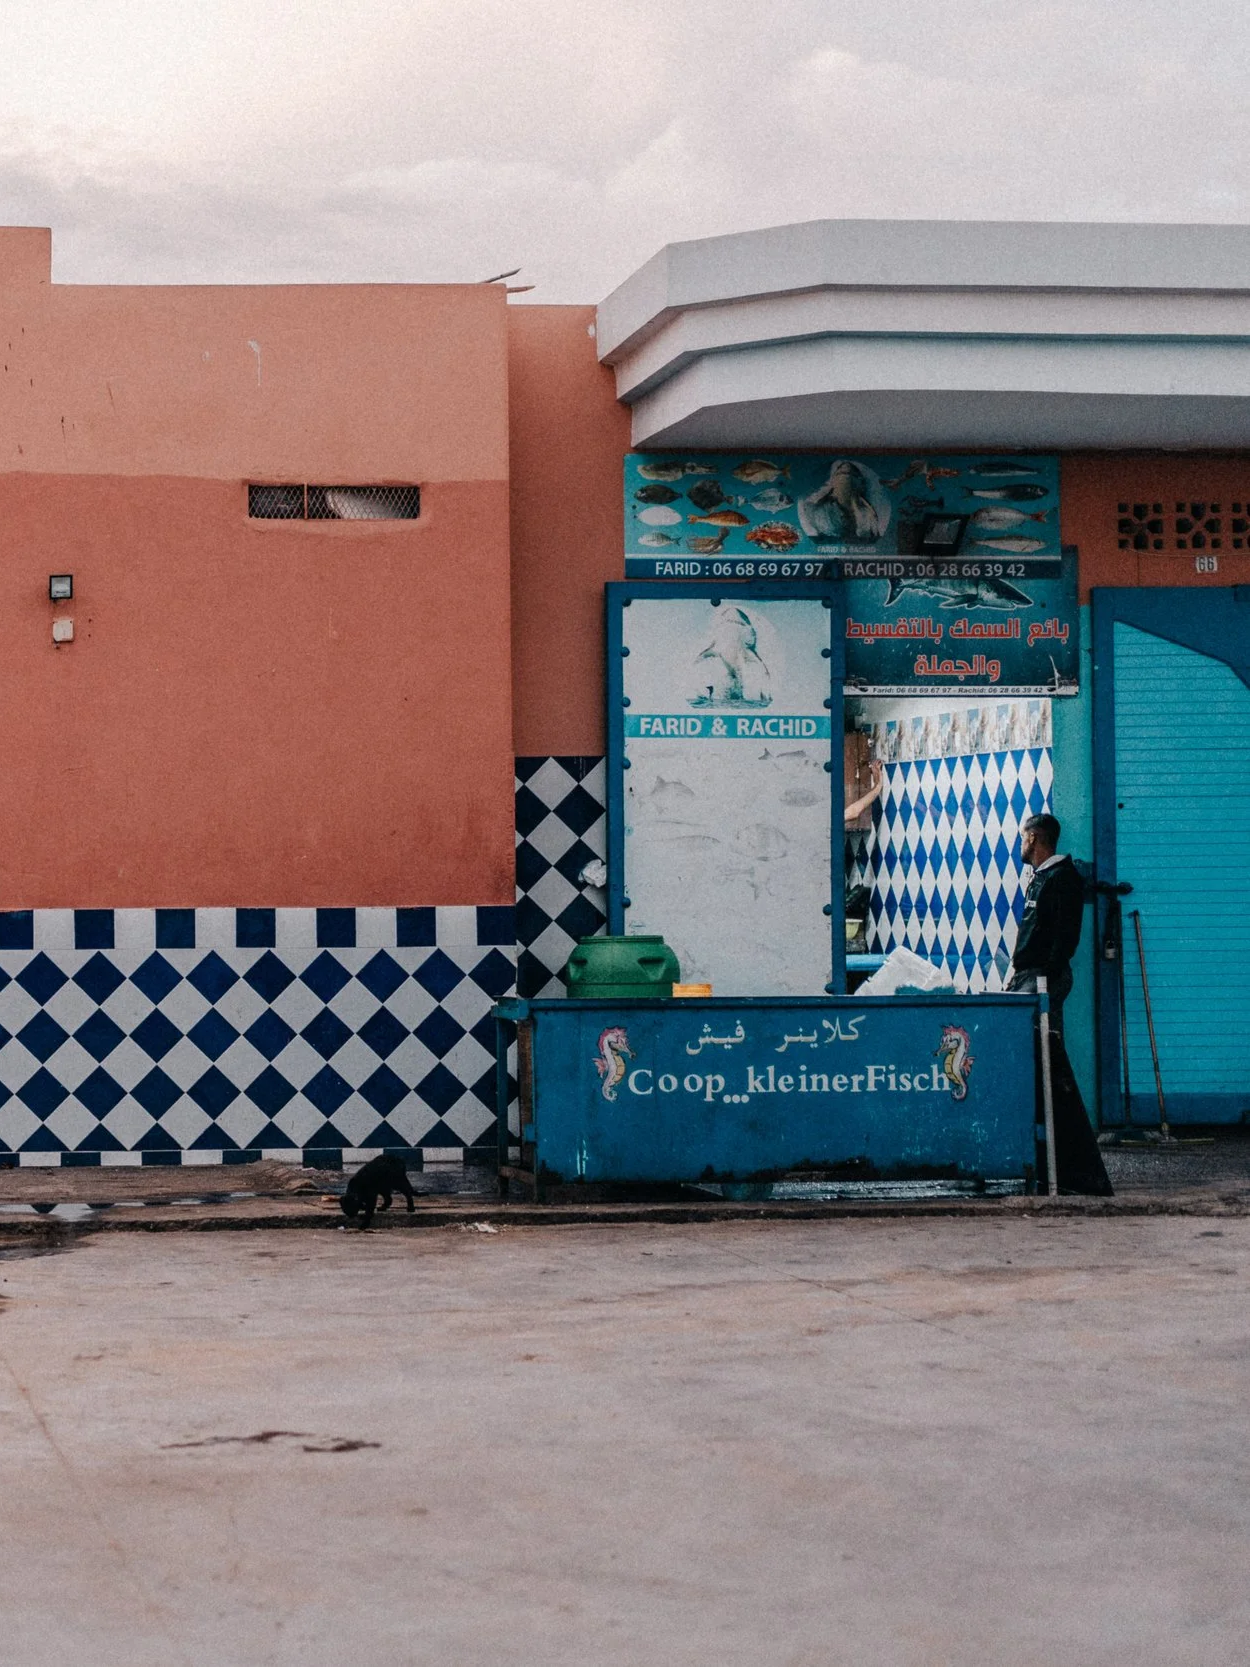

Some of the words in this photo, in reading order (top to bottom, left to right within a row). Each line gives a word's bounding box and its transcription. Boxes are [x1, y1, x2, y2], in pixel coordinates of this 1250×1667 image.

[655, 562, 701, 576] FARID
[712, 562, 732, 576] 06
[735, 562, 755, 576] 68
[758, 562, 778, 576] 69
[781, 562, 801, 576] 67
[804, 562, 824, 576] 97
[843, 563, 905, 577] RACHID
[916, 563, 936, 577] 06
[940, 563, 958, 577] 28
[961, 563, 981, 577] 66
[984, 563, 1003, 577] 39
[1006, 563, 1026, 577] 42
[845, 618, 943, 645] بالتقسيط
[949, 618, 1021, 639] السمك
[1027, 618, 1070, 647] بائع
[913, 654, 1001, 682] والجملة
[896, 686, 906, 694] 06
[942, 686, 952, 694] 97
[988, 686, 998, 694] 06
[1033, 686, 1043, 694] 42
[639, 717, 702, 737] FARID
[711, 718, 728, 736] &
[736, 717, 817, 737] RACHID
[686, 1020, 746, 1055] فيش
[775, 1015, 866, 1052] كلاينر
